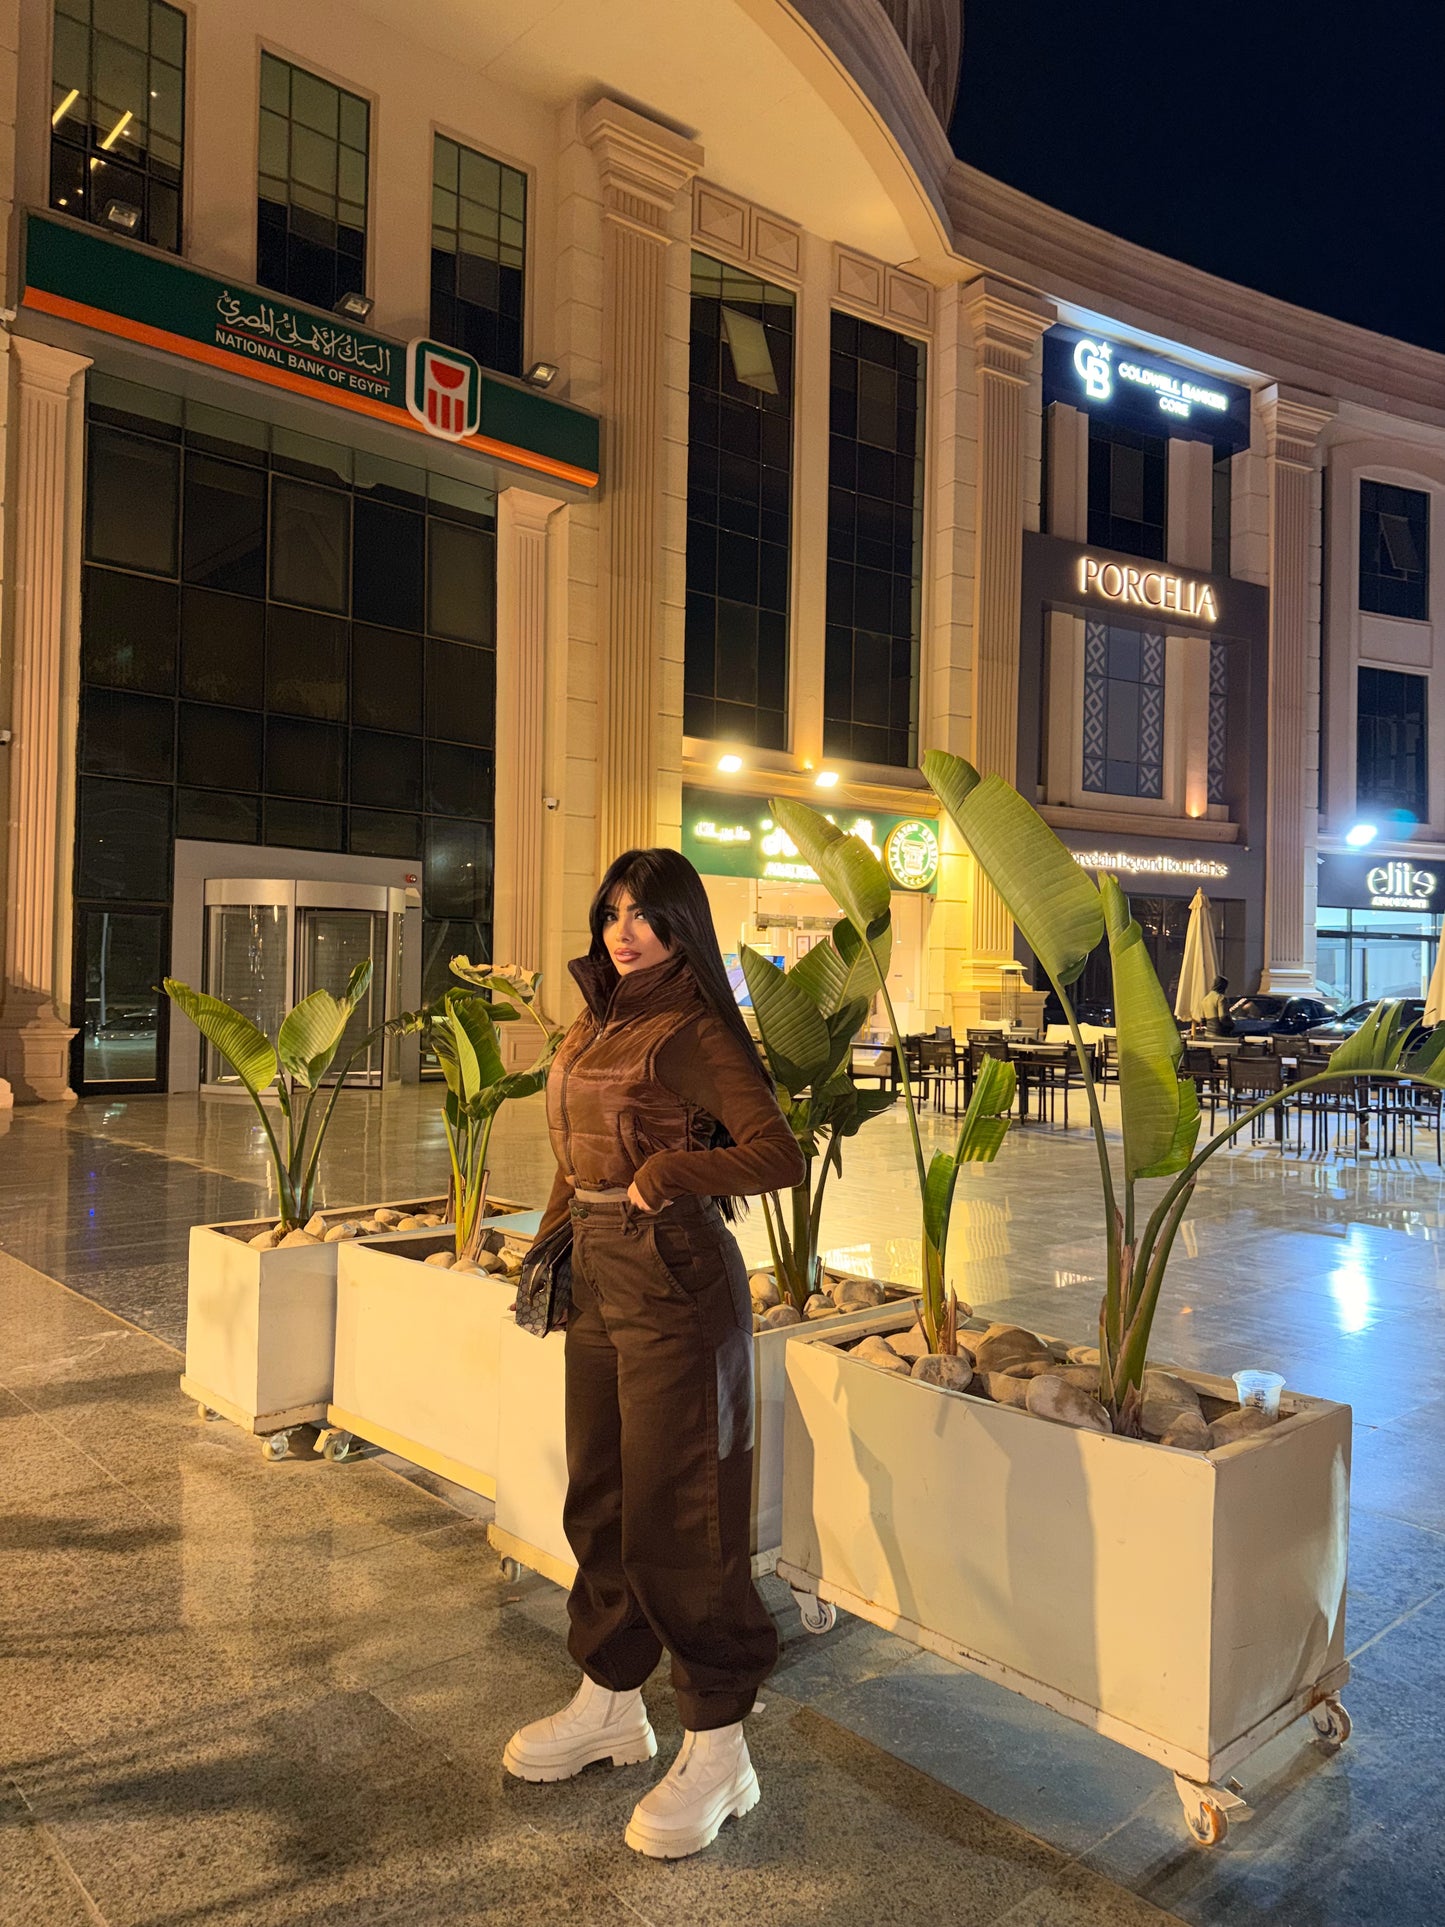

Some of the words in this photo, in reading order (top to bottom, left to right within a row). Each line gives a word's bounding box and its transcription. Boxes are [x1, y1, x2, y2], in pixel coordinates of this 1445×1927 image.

[215, 330, 285, 364] NATIONAL
[288, 354, 326, 378] BANK
[328, 368, 346, 384] OF
[349, 374, 391, 399] EGYPT
[1118, 362, 1181, 397] COLDWELL
[1079, 556, 1218, 621] PORCELIA
